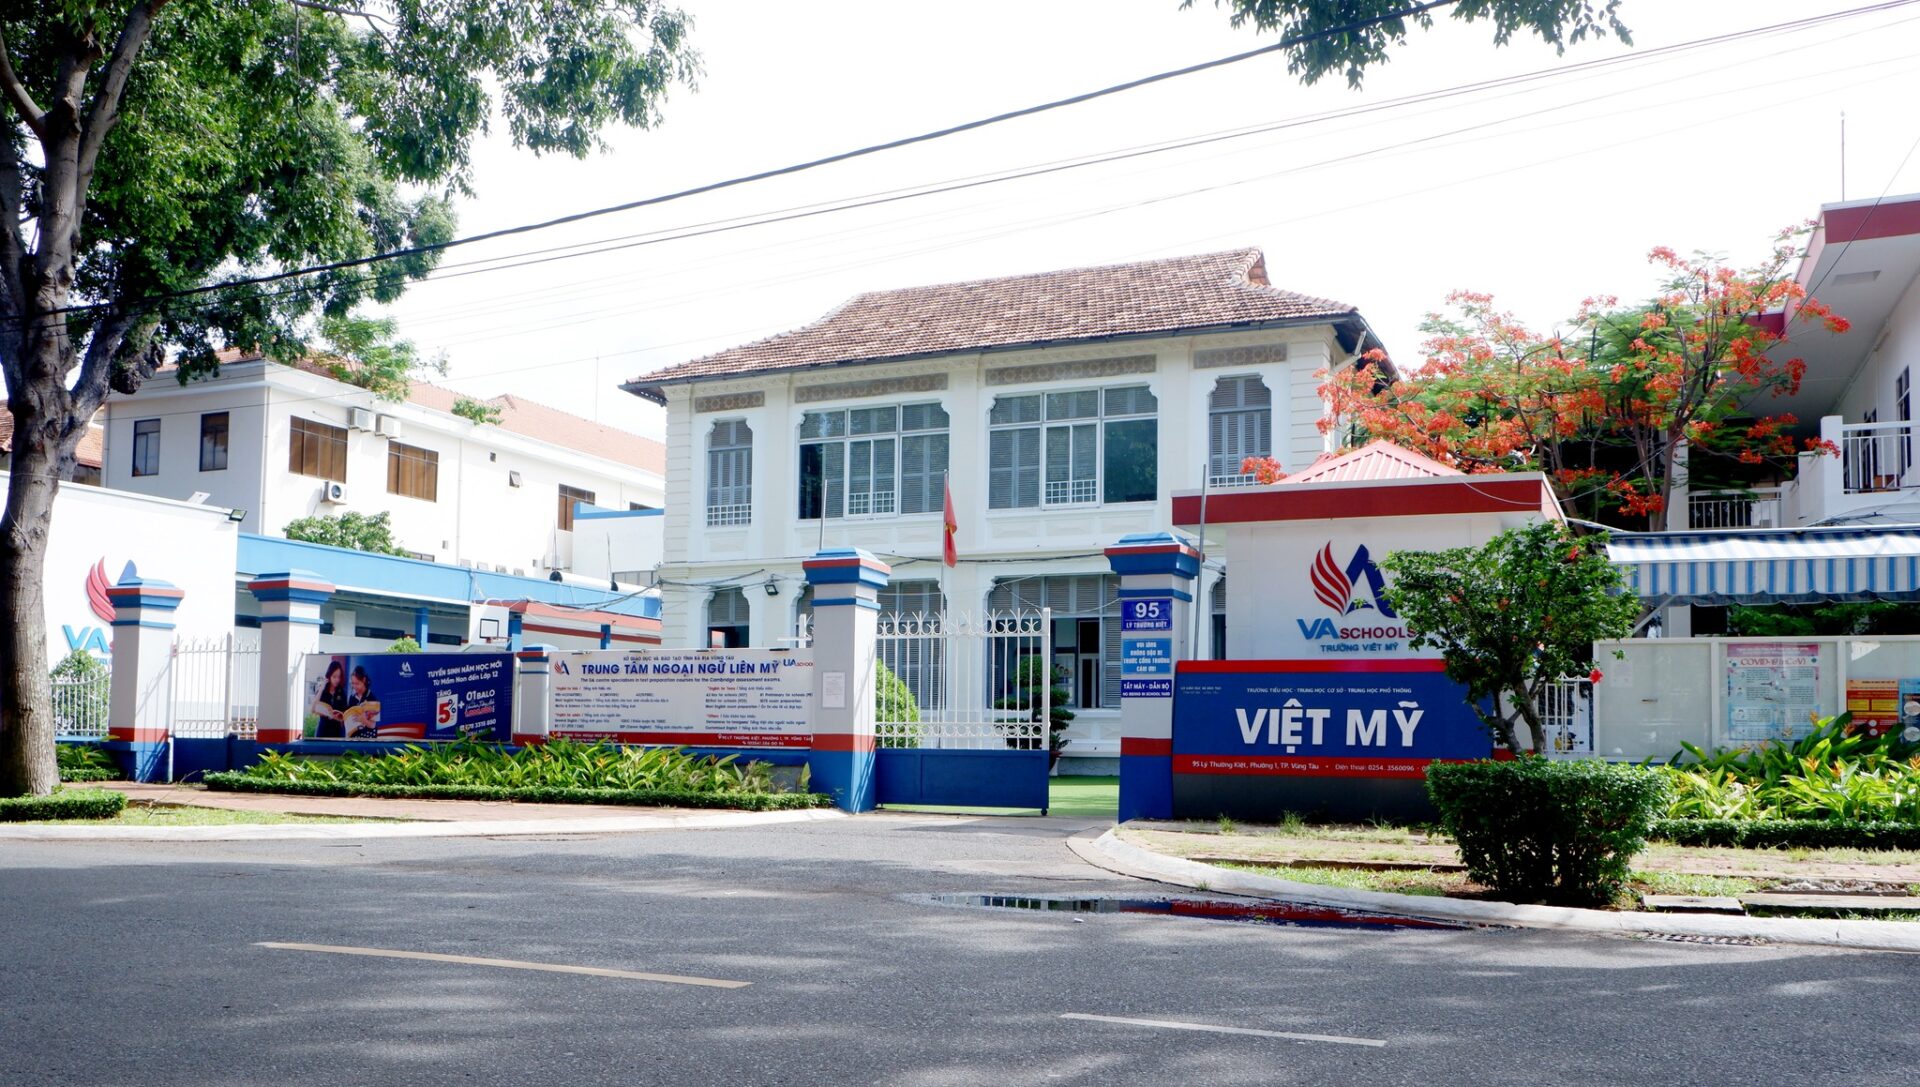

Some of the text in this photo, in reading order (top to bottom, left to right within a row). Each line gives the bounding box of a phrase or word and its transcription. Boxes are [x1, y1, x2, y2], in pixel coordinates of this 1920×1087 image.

[1135, 602, 1159, 618] 95
[1296, 618, 1340, 640] VA
[1320, 642, 1359, 653] TRƯỜNG
[1385, 641, 1399, 652] MỸ
[446, 668, 461, 676] SINH
[461, 664, 475, 674] NĂM
[475, 662, 489, 672] HỌC
[489, 659, 502, 670] MỚI
[492, 670, 499, 678] 12
[581, 660, 779, 678] TRUNG TÂM NGOẠI NGỮ LIÊN MỸ
[466, 688, 495, 701] 01 BALO
[438, 699, 456, 723] 5%
[1235, 698, 1425, 754] VIỆT MỸ
[1200, 760, 1208, 769] Lý
[1209, 760, 1233, 770] Thường
[1234, 761, 1248, 770] Kiệt,
[1250, 762, 1274, 770] Phường
[1291, 763, 1307, 771] Vũng
